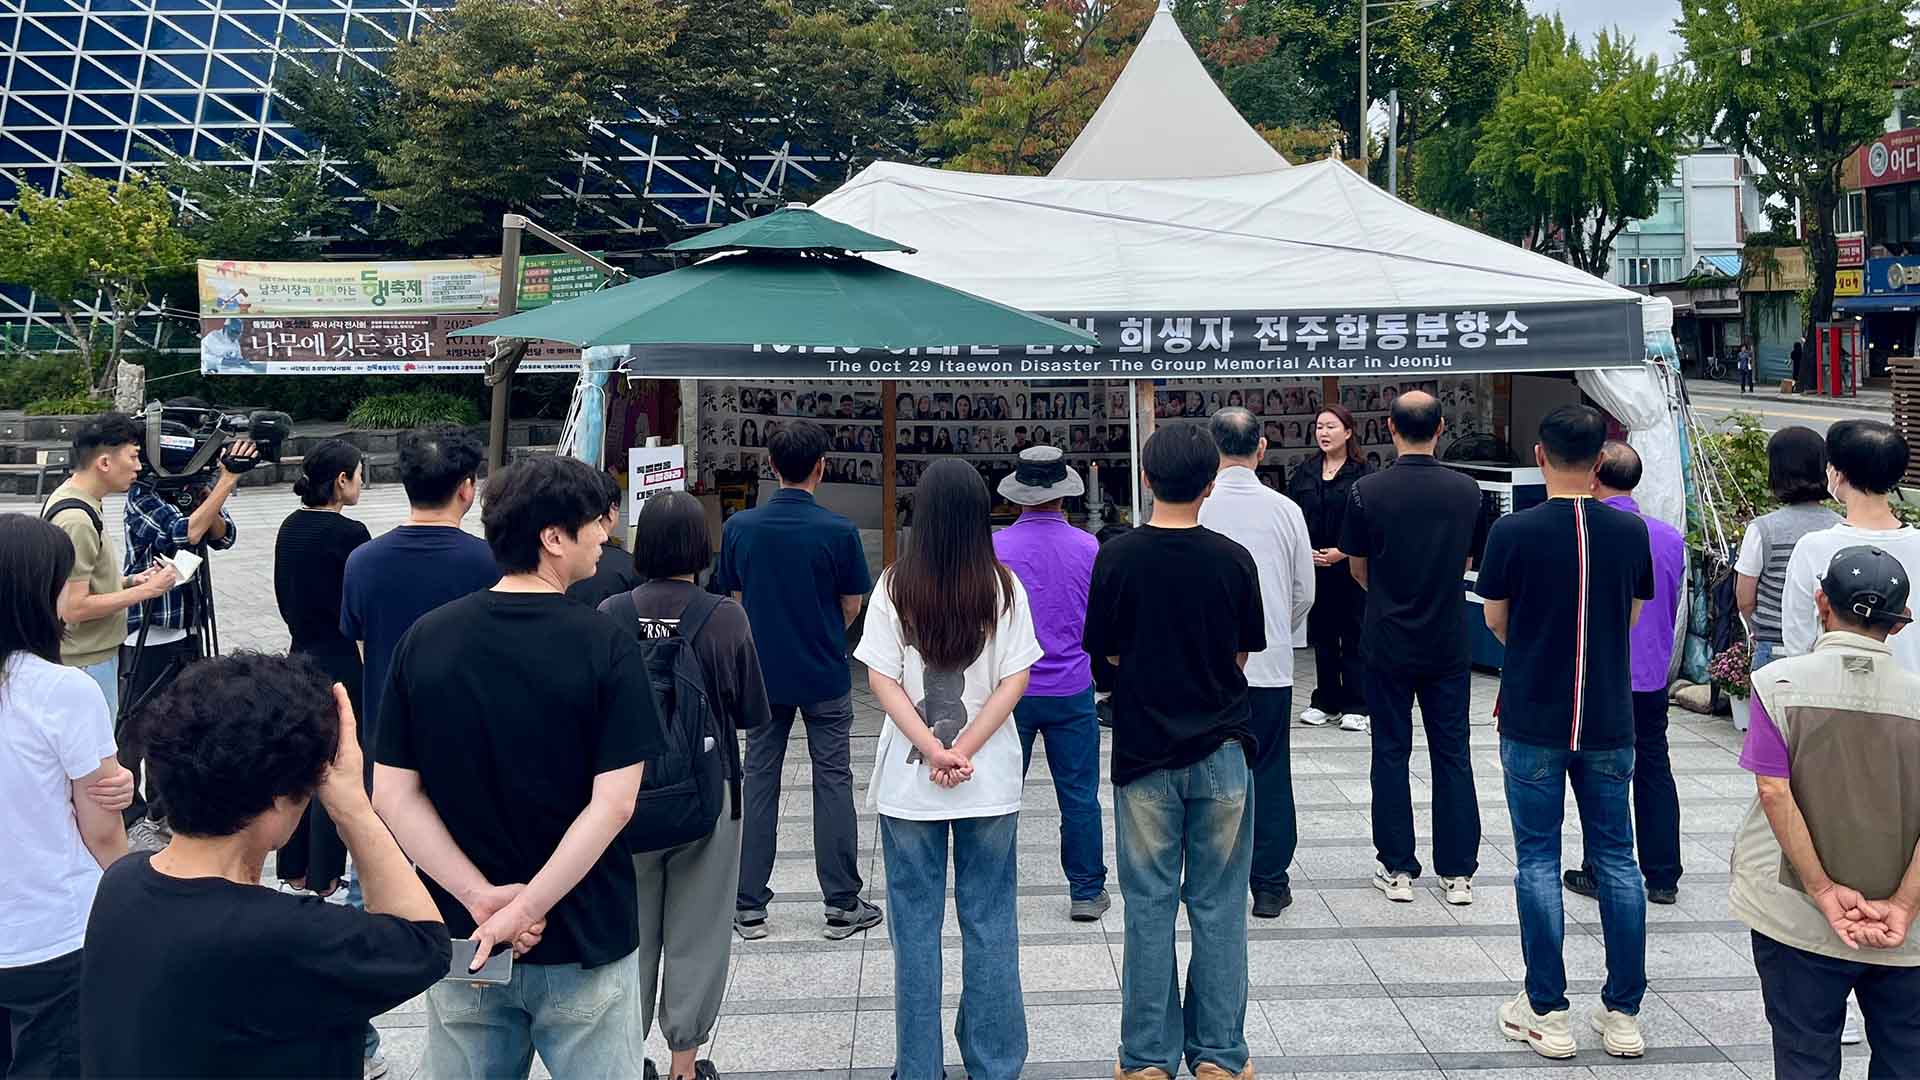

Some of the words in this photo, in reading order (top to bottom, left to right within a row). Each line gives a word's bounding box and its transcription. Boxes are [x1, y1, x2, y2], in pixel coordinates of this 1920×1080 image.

[259, 284, 311, 297] 남부시장과
[444, 319, 472, 330] 2025
[1118, 317, 1234, 354] 희생자
[1254, 310, 1528, 351] 전주합동분향소
[251, 332, 326, 357] 나무에
[331, 332, 380, 357] 깃든
[385, 332, 435, 357] 평화
[827, 360, 861, 373] The
[870, 360, 901, 373] Oct
[909, 360, 931, 373] 29
[940, 360, 1013, 373] Itaewon
[1021, 359, 1102, 372] Disaster
[1109, 359, 1144, 372] The
[1151, 358, 1206, 374] Group
[1214, 356, 1299, 371] Memorial
[1307, 356, 1357, 369] Altar
[1364, 355, 1382, 368] in
[1388, 354, 1452, 371] Jeonju
